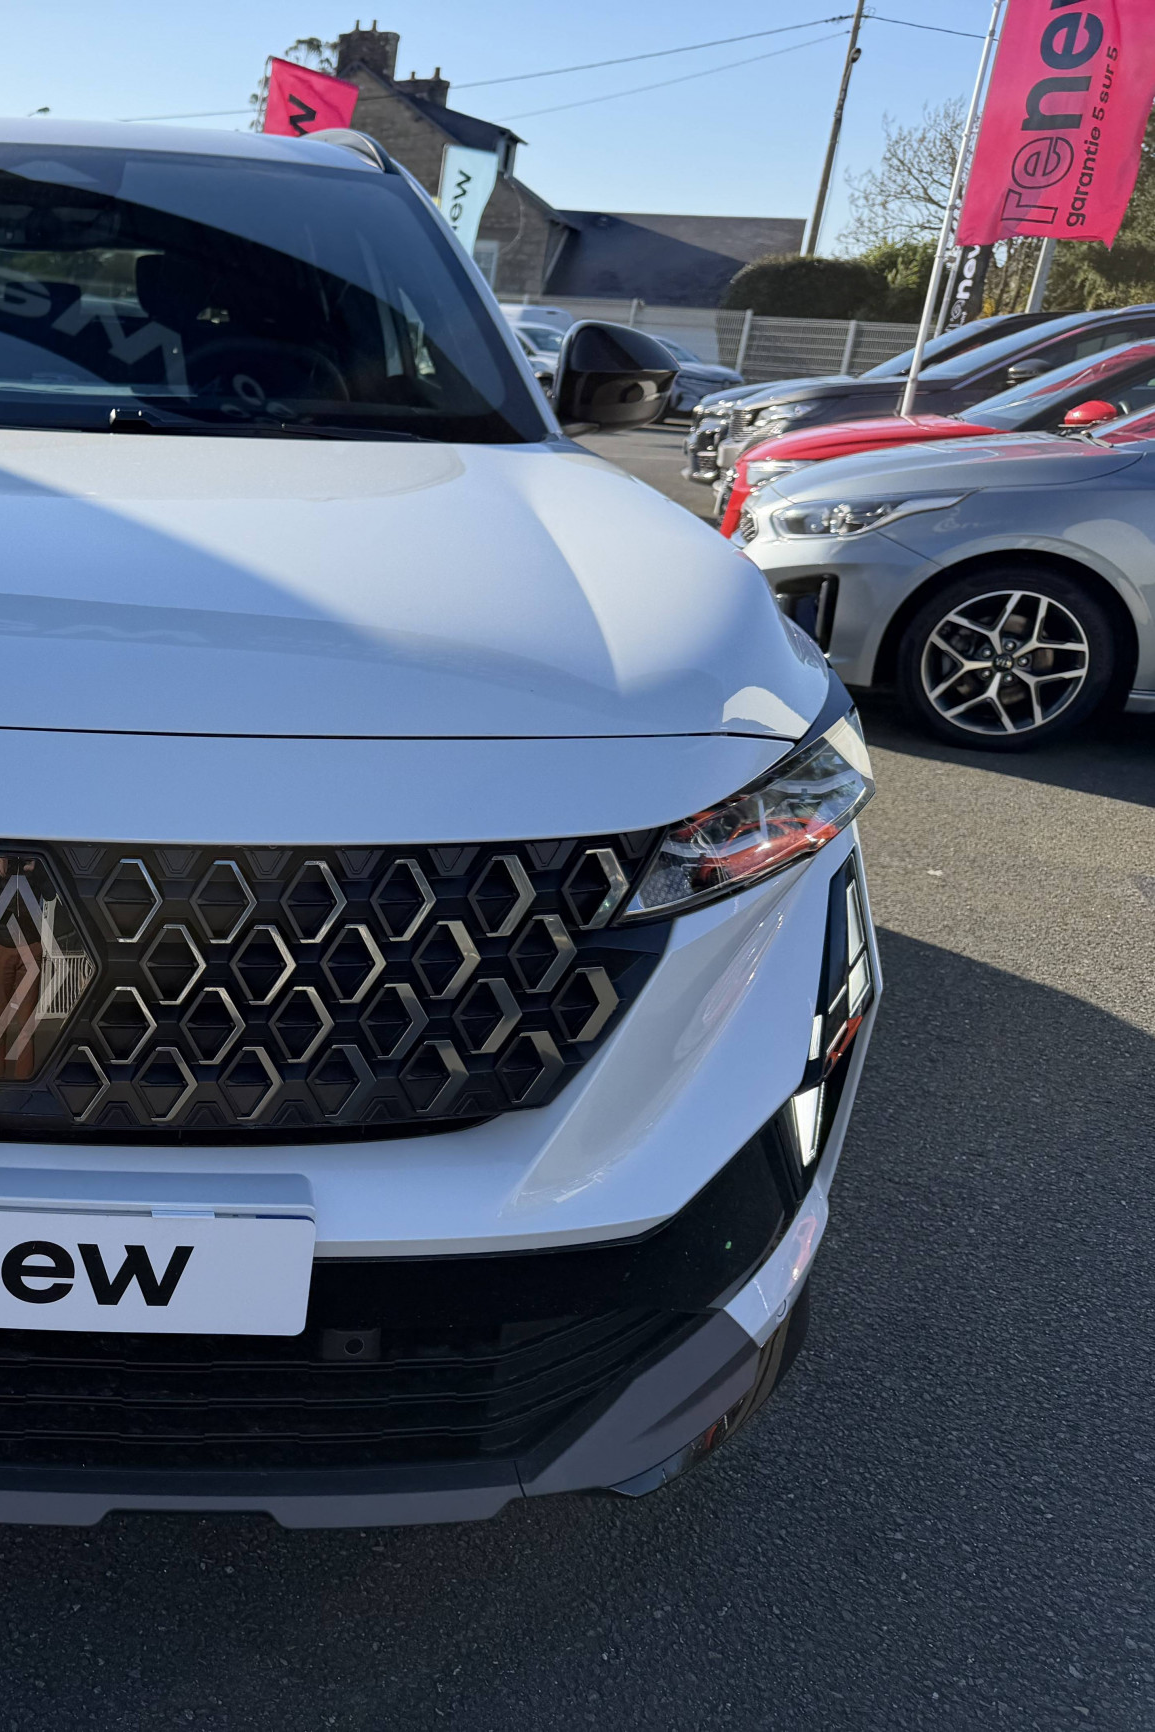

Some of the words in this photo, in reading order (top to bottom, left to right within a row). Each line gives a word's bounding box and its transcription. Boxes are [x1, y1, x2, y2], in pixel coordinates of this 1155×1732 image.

[1106, 46, 1119, 62] 5
[1099, 63, 1115, 104] sur
[1000, 0, 1105, 225] rene
[1091, 106, 1105, 122] 5
[1066, 126, 1101, 227] garantie
